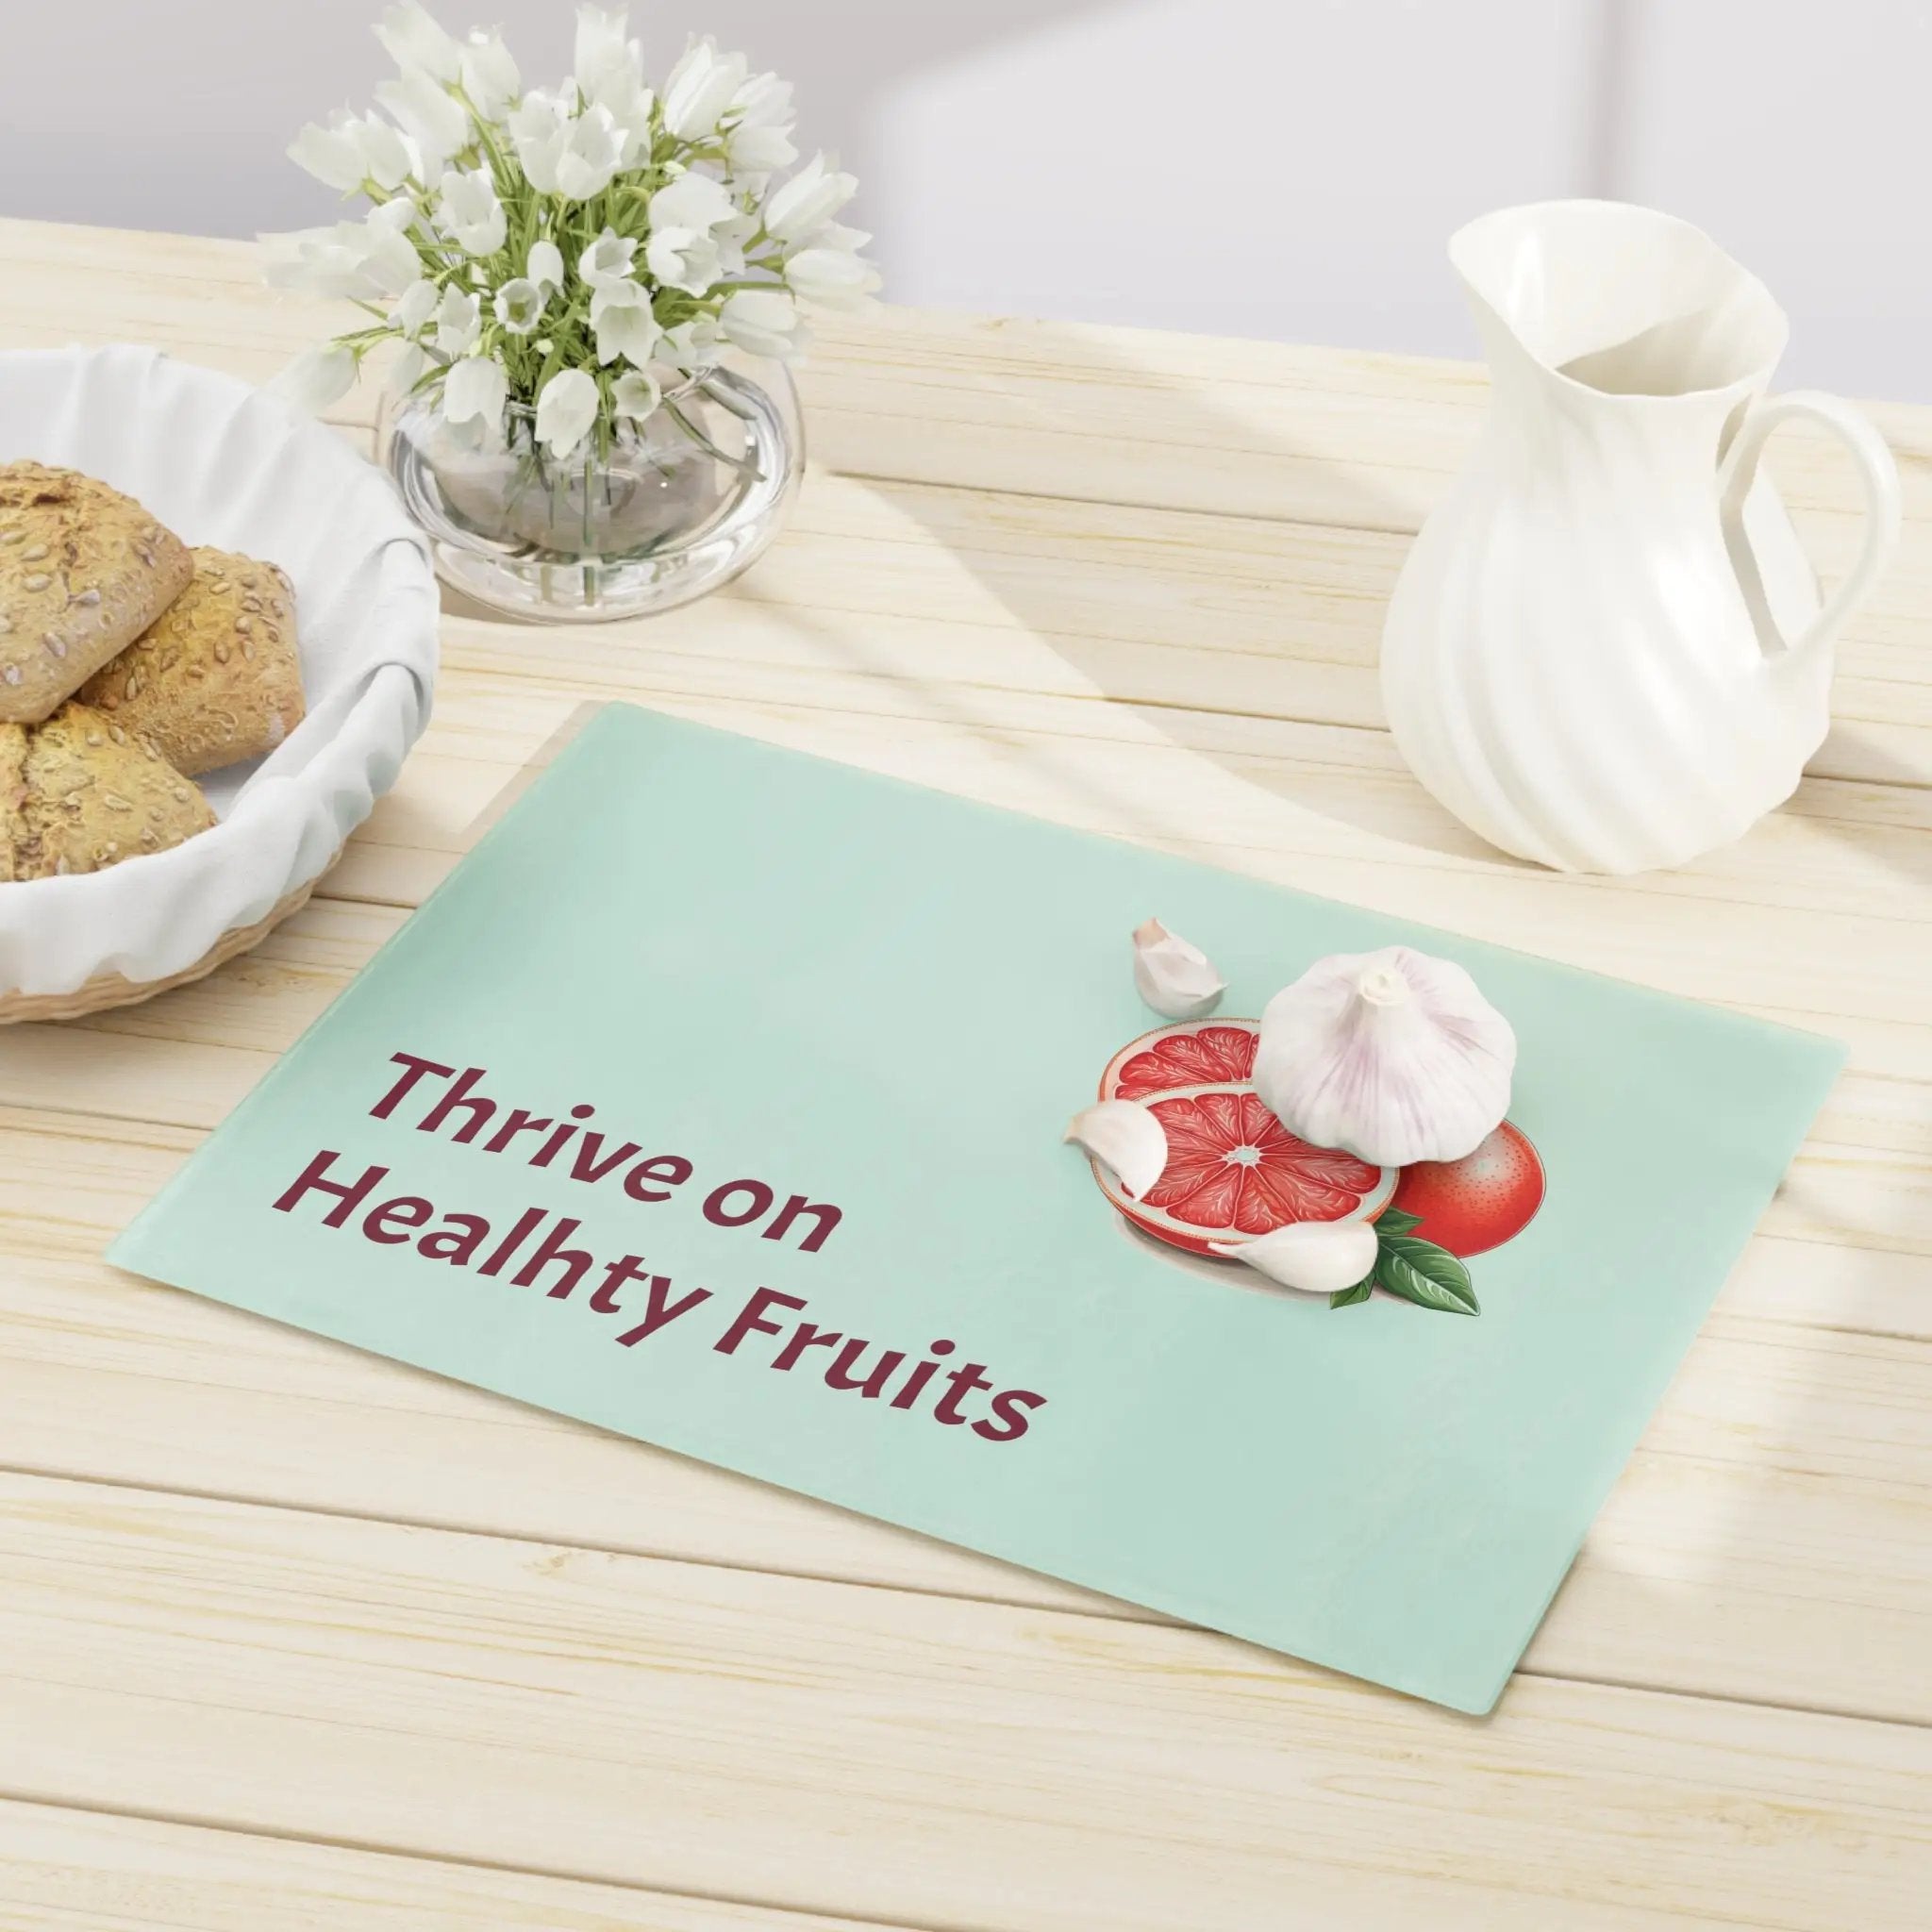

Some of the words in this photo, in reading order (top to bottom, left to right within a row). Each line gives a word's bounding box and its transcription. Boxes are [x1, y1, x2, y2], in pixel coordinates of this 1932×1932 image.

[372, 1052, 693, 1203] Thrive
[703, 1179, 842, 1252] on
[274, 1150, 712, 1347] Healhty
[714, 1287, 1047, 1441] Fruits
